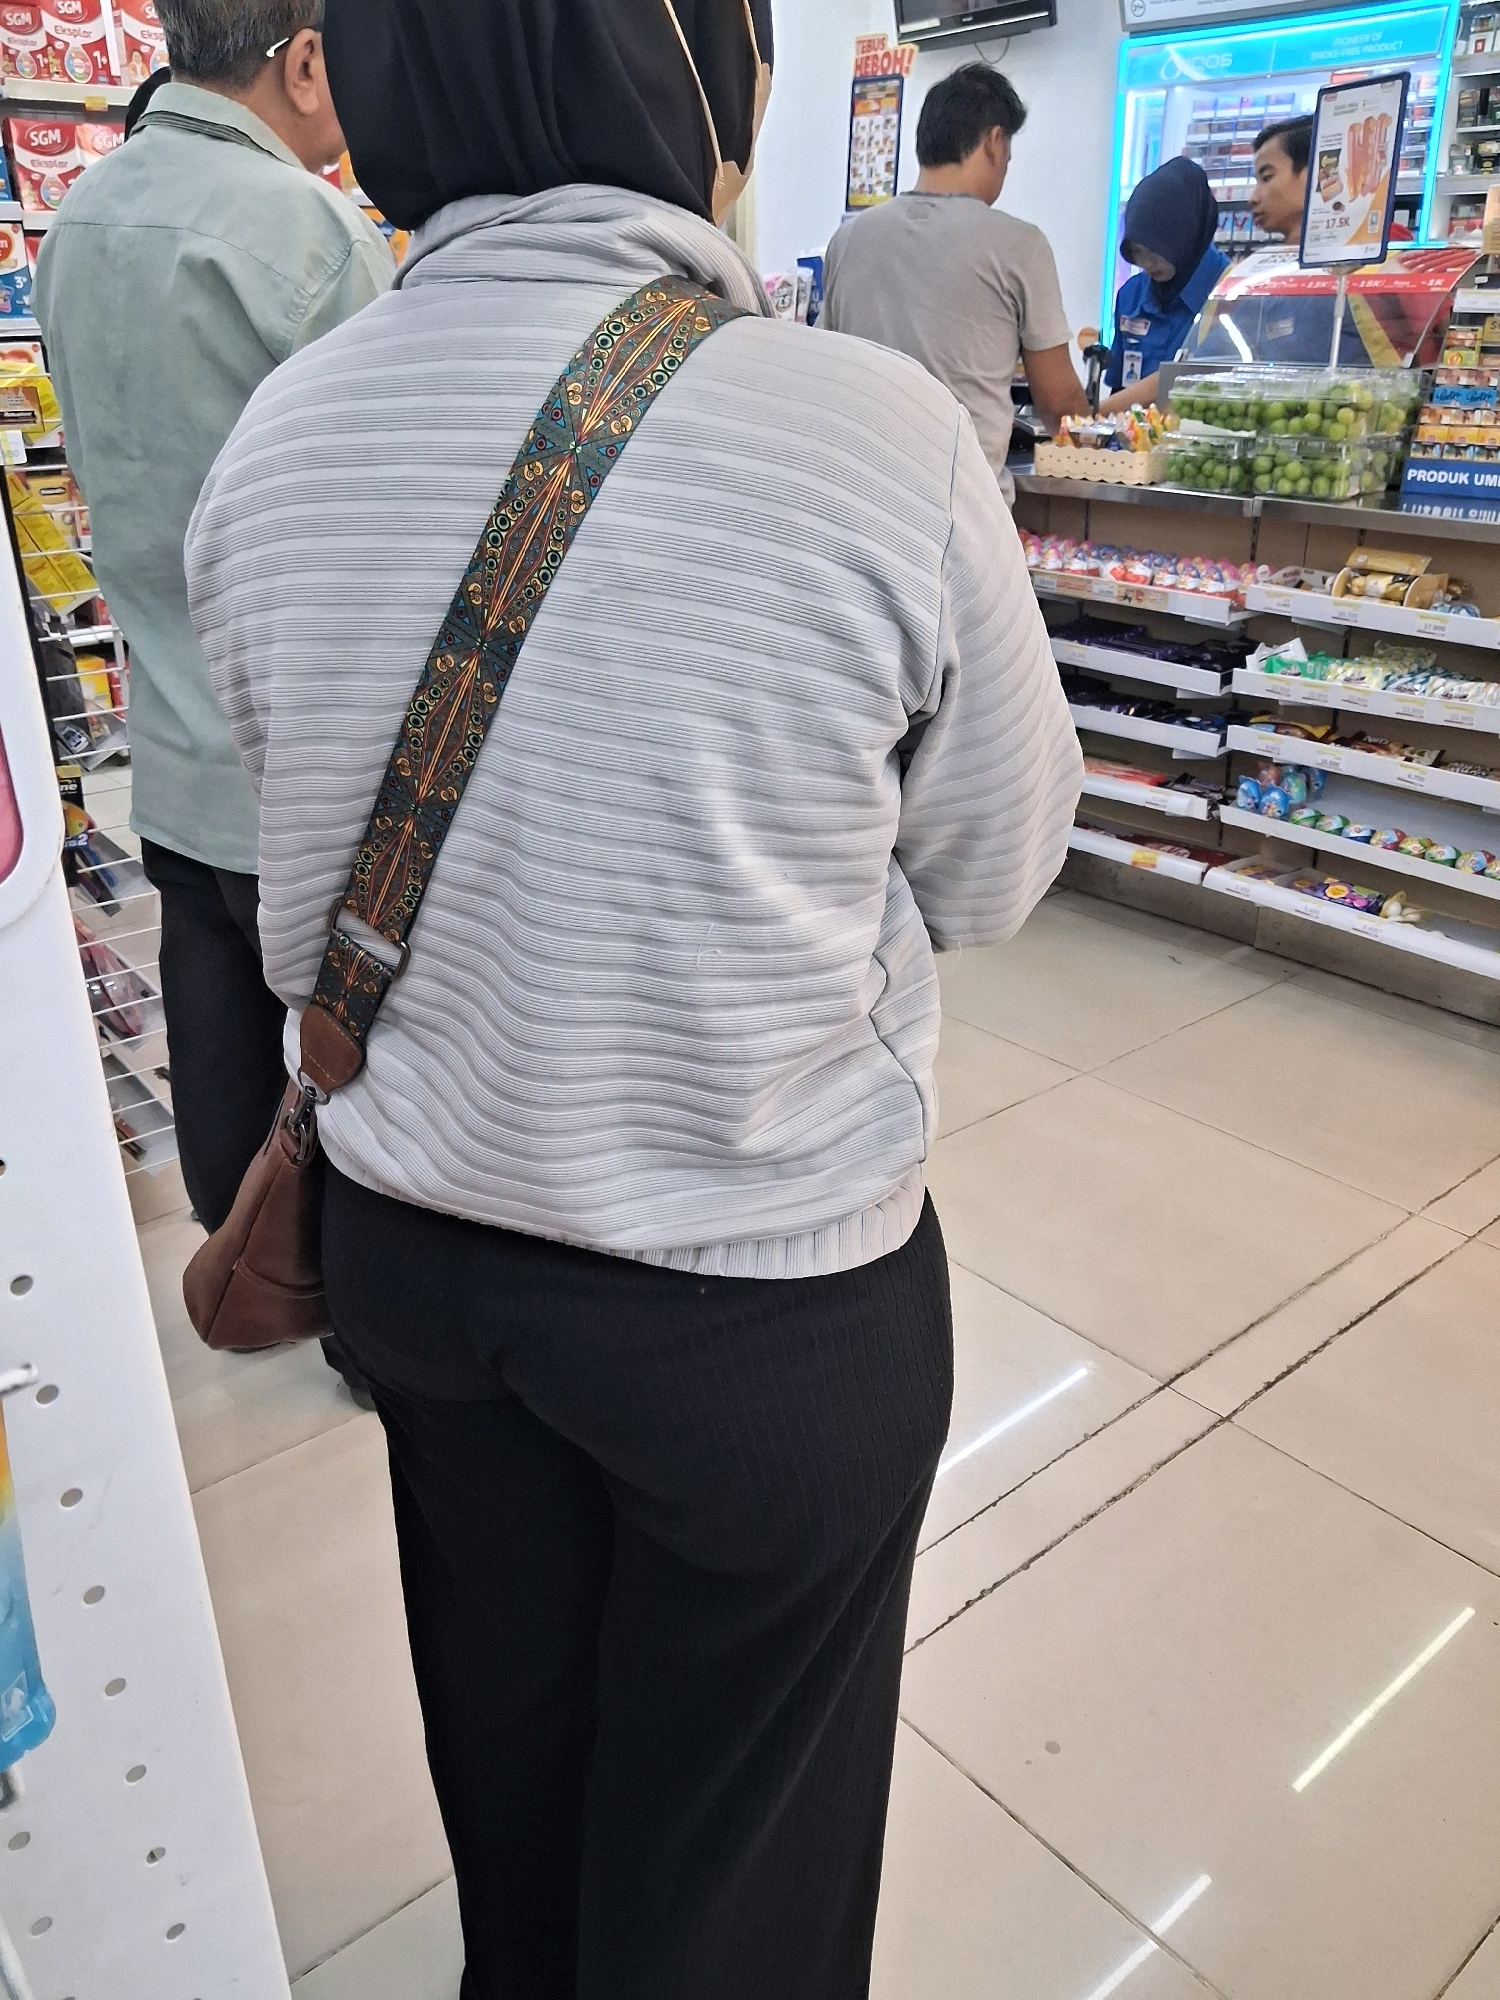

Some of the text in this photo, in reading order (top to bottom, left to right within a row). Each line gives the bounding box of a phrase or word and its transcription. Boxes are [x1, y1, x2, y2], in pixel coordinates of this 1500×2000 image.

[57, 0, 82, 14] SGM
[5, 12, 32, 26] SGM
[140, 30, 165, 42] Eksp
[1334, 31, 1383, 46] PIONEER OF
[857, 37, 886, 56] TEBUS
[1310, 41, 1404, 61] SMOKE-FREE PRODUCT
[93, 50, 108, 69] 1+
[855, 48, 915, 77] HEBOH!
[29, 129, 61, 147] SGM
[93, 133, 125, 149] SGM
[1325, 216, 1350, 229] 17.5K
[1407, 468, 1470, 485] PRODUK
